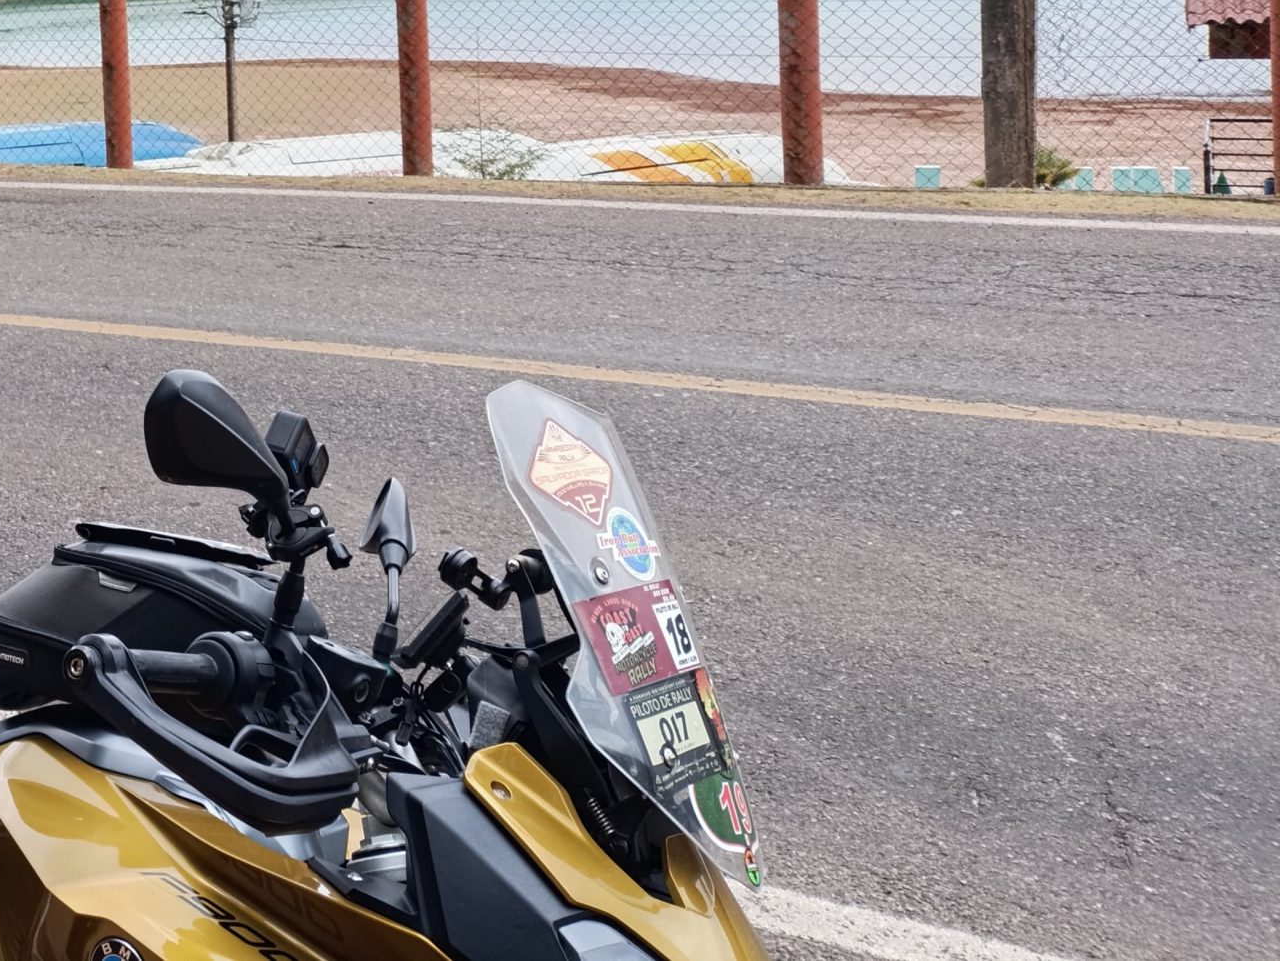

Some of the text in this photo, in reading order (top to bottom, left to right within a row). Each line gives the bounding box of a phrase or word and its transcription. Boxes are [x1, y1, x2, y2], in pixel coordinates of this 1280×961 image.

[574, 494, 601, 514] 12
[599, 536, 619, 548] Iron
[617, 545, 659, 558] Association
[600, 607, 633, 628] COAST
[623, 623, 644, 644] COAST
[666, 613, 692, 656] 18
[615, 642, 657, 672] MOTORCYCLE
[627, 657, 657, 686] RALLY
[630, 697, 661, 719] PILOTO
[659, 693, 673, 710] DE
[670, 686, 692, 704] RALLY
[659, 711, 689, 748] 017
[719, 782, 752, 835] 19
